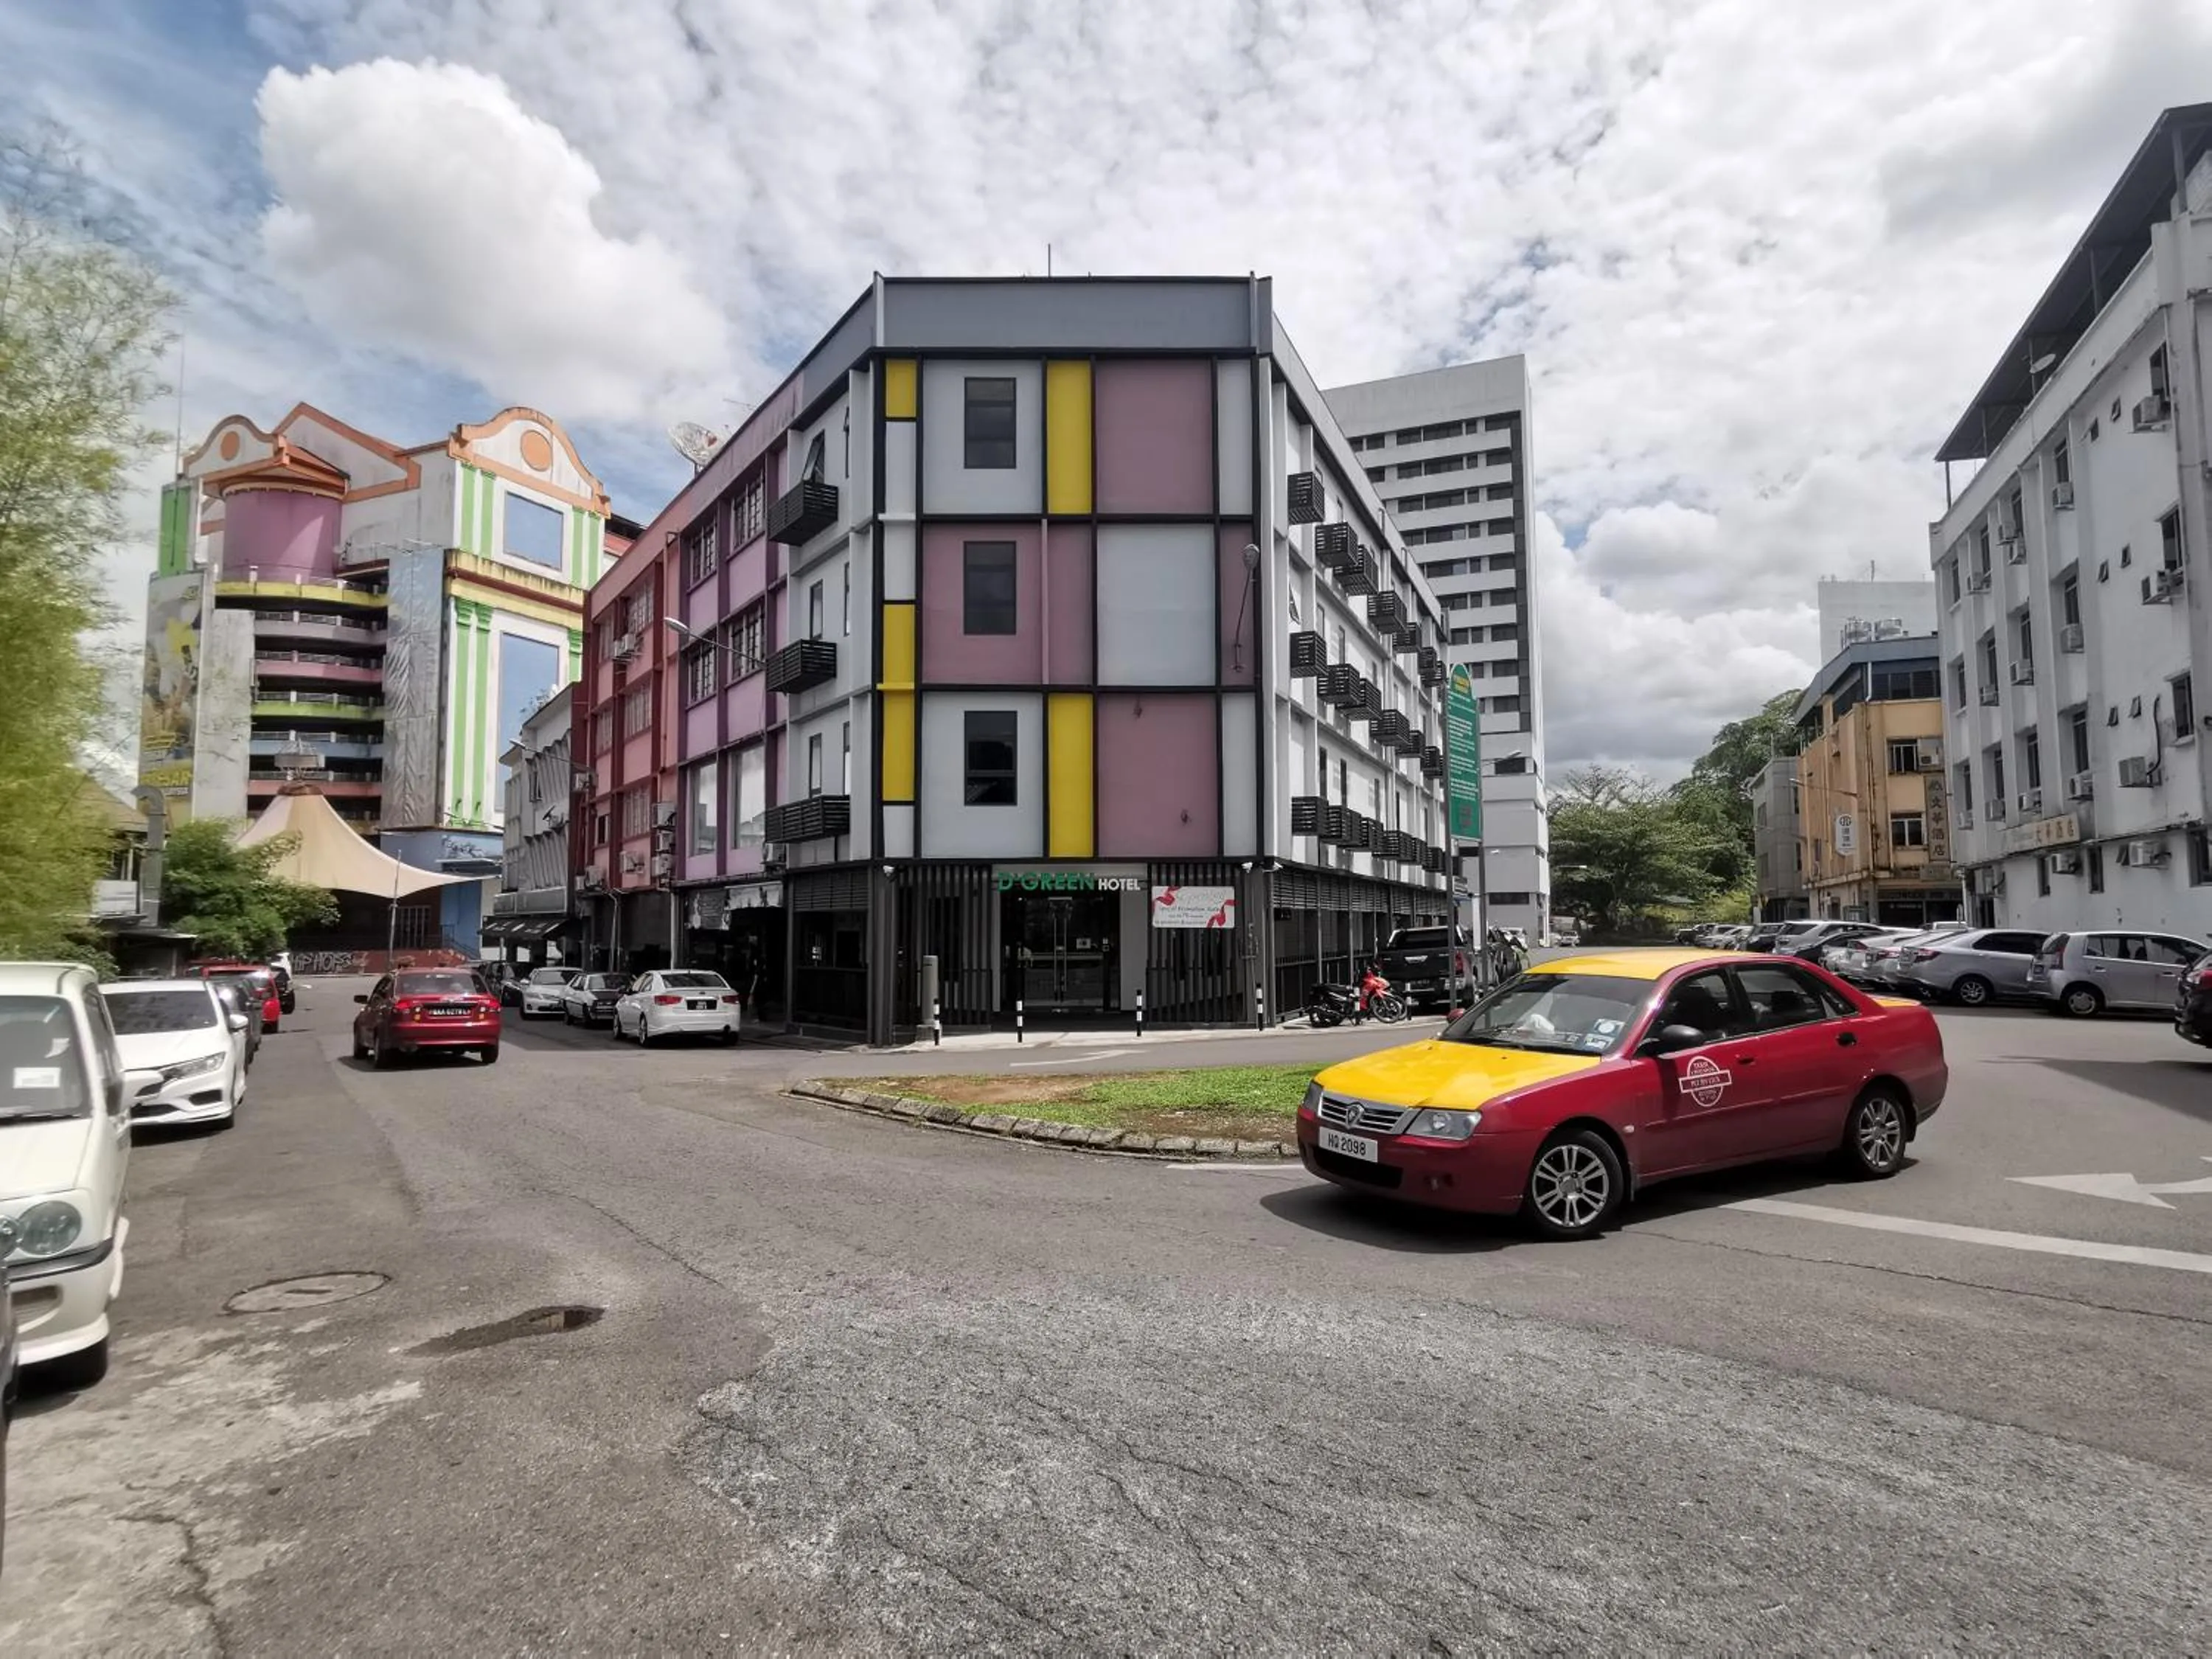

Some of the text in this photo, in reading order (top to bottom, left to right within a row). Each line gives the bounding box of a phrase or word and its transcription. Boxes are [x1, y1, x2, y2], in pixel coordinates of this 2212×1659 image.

[998, 872, 1141, 891] D'GREEN HOTEL
[1341, 1136, 1366, 1155] 2098
